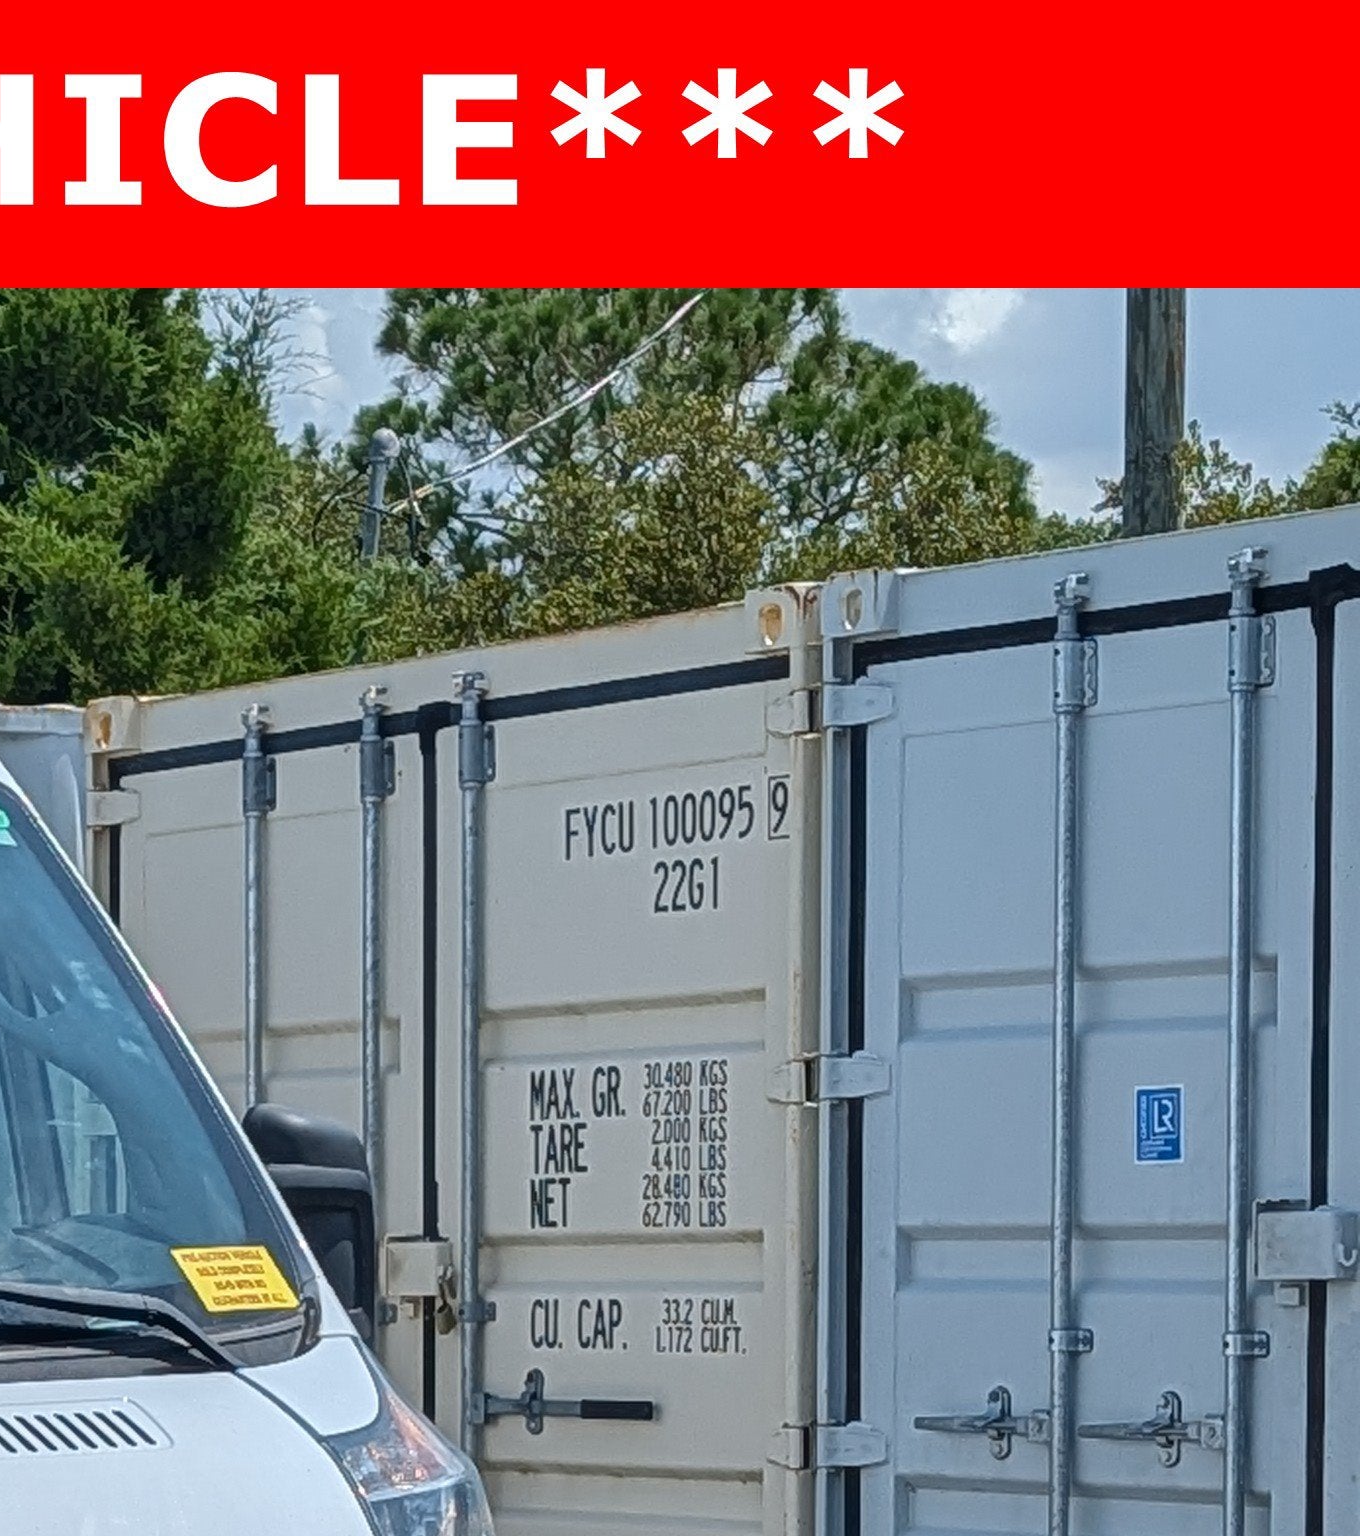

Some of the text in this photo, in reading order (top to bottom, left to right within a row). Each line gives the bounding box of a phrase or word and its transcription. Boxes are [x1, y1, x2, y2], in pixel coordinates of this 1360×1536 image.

[564, 781, 789, 861] FYCU 100095 9
[654, 856, 719, 913] 22G1
[699, 1059, 728, 1086] KGS
[529, 1065, 626, 1121] MAX. GR.
[699, 1088, 728, 1115] LBS
[529, 1122, 588, 1174] TARE
[699, 1117, 728, 1143] KGS
[699, 1144, 728, 1171] LBS
[530, 1178, 571, 1229] NET
[699, 1173, 728, 1199] KGS
[699, 1201, 728, 1227] LBS
[530, 1298, 627, 1350] CU. CAP.
